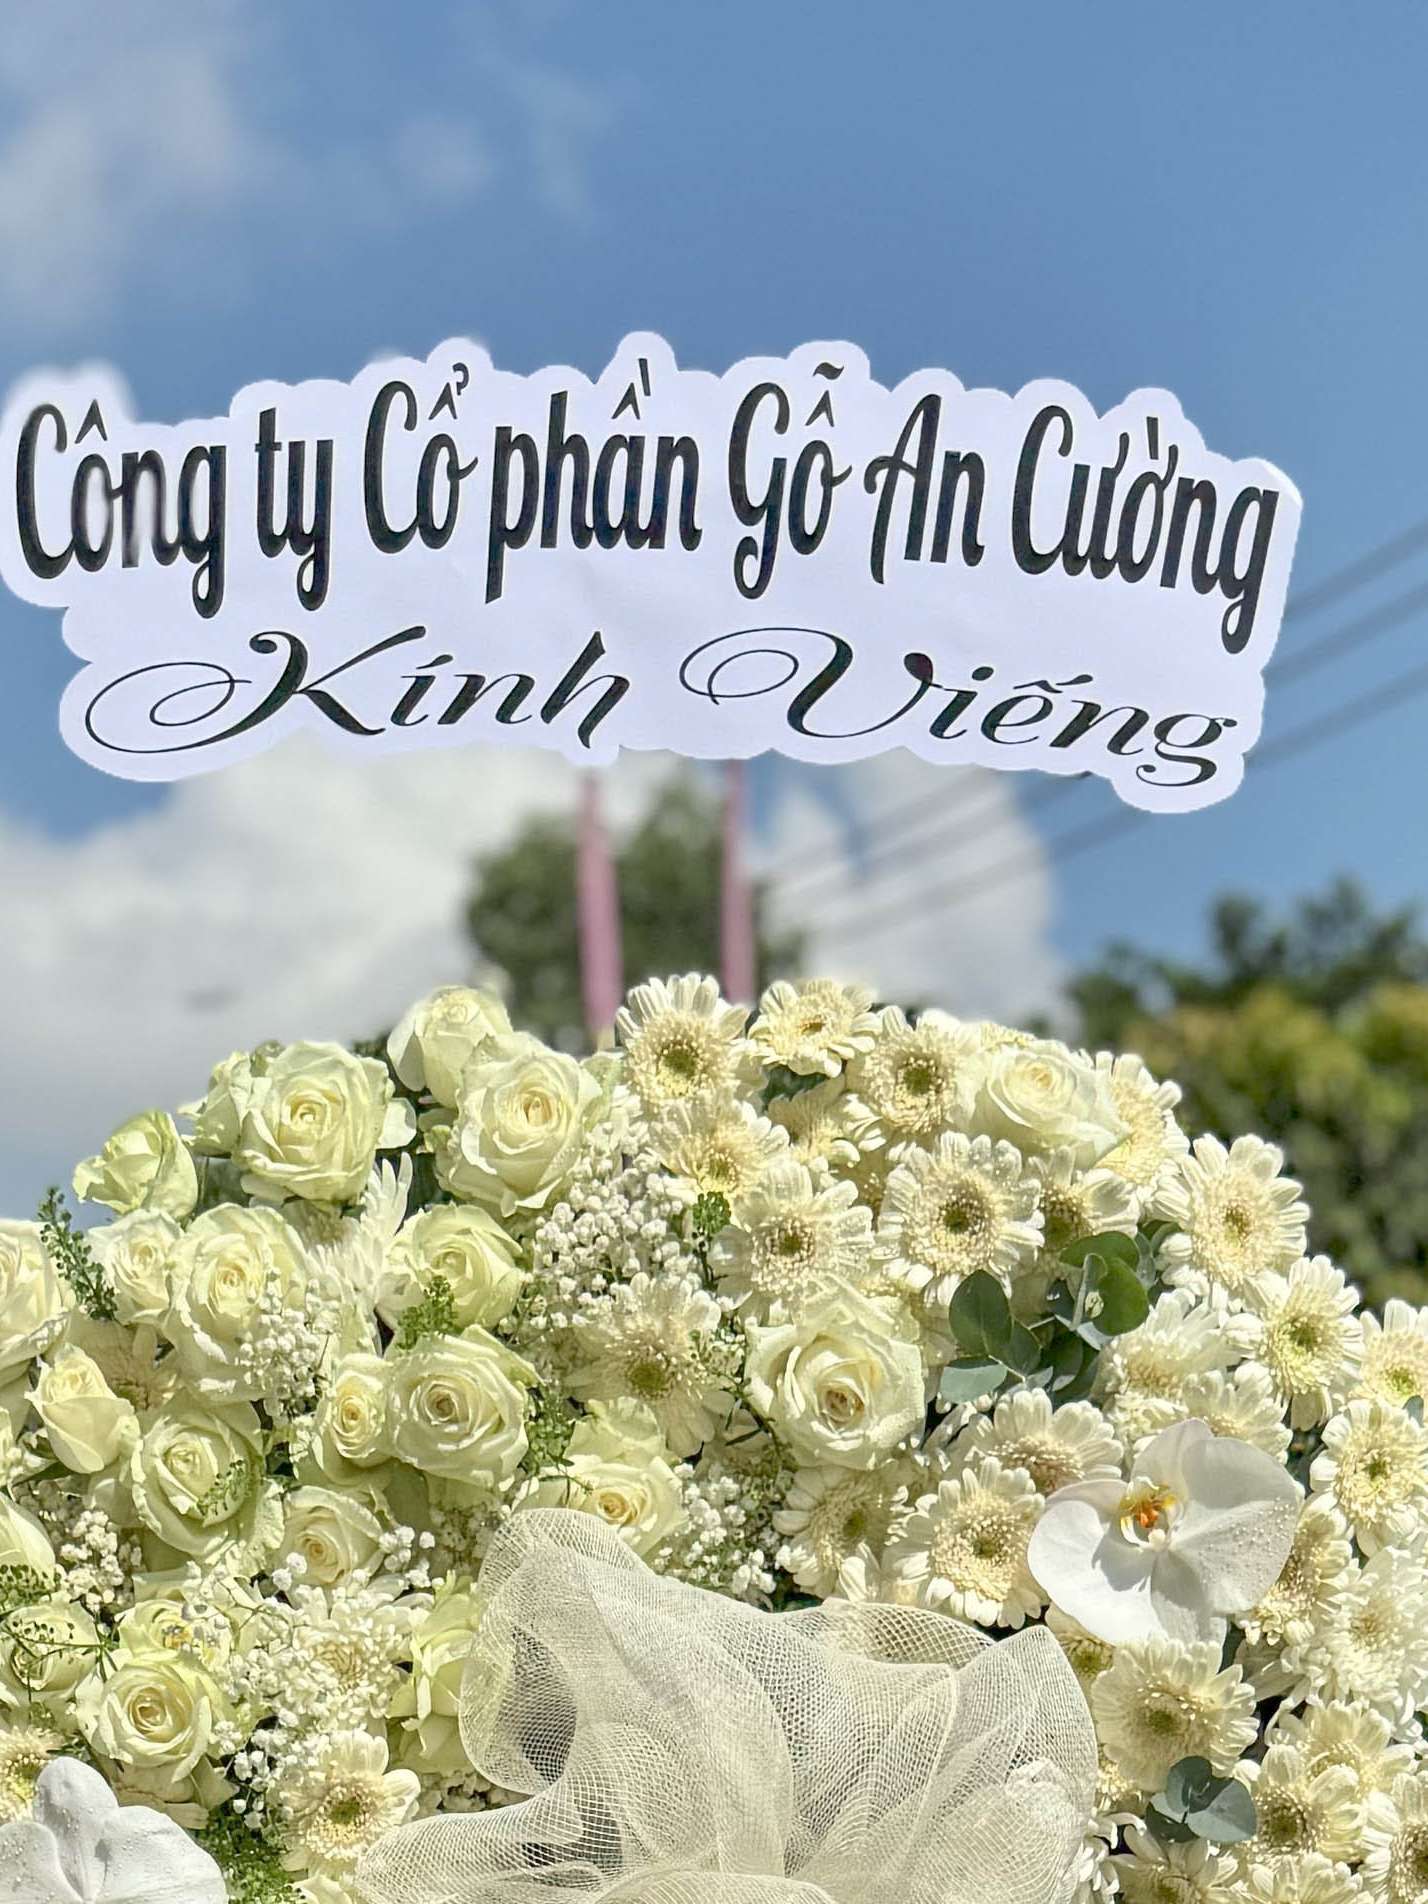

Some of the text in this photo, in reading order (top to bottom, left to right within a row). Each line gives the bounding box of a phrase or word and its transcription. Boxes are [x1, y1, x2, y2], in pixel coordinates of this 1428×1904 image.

[14, 357, 1281, 655] Công ty Cổ phần Gỗ An Cường
[83, 625, 1240, 788] Kính Viếng
